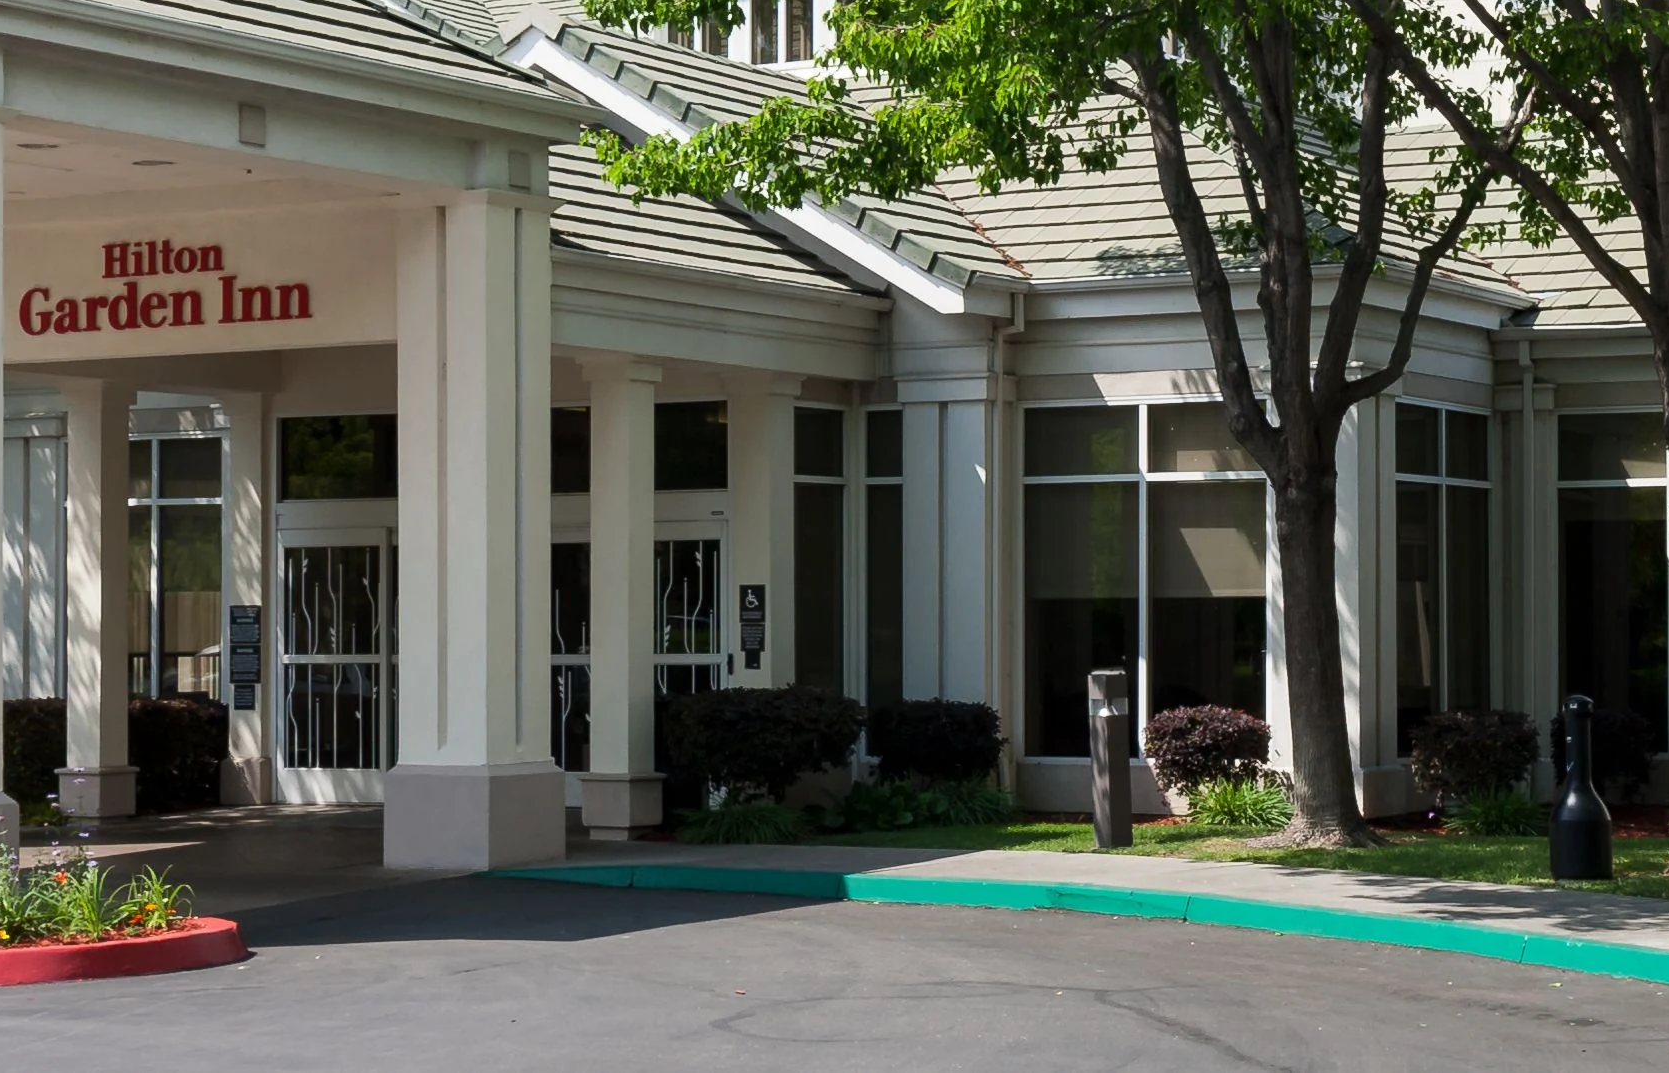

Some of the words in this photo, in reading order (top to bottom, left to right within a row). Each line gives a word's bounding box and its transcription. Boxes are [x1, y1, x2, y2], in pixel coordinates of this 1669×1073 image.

[101, 239, 224, 279] Hilton
[18, 281, 205, 336] Garden
[218, 275, 312, 324] Inn
